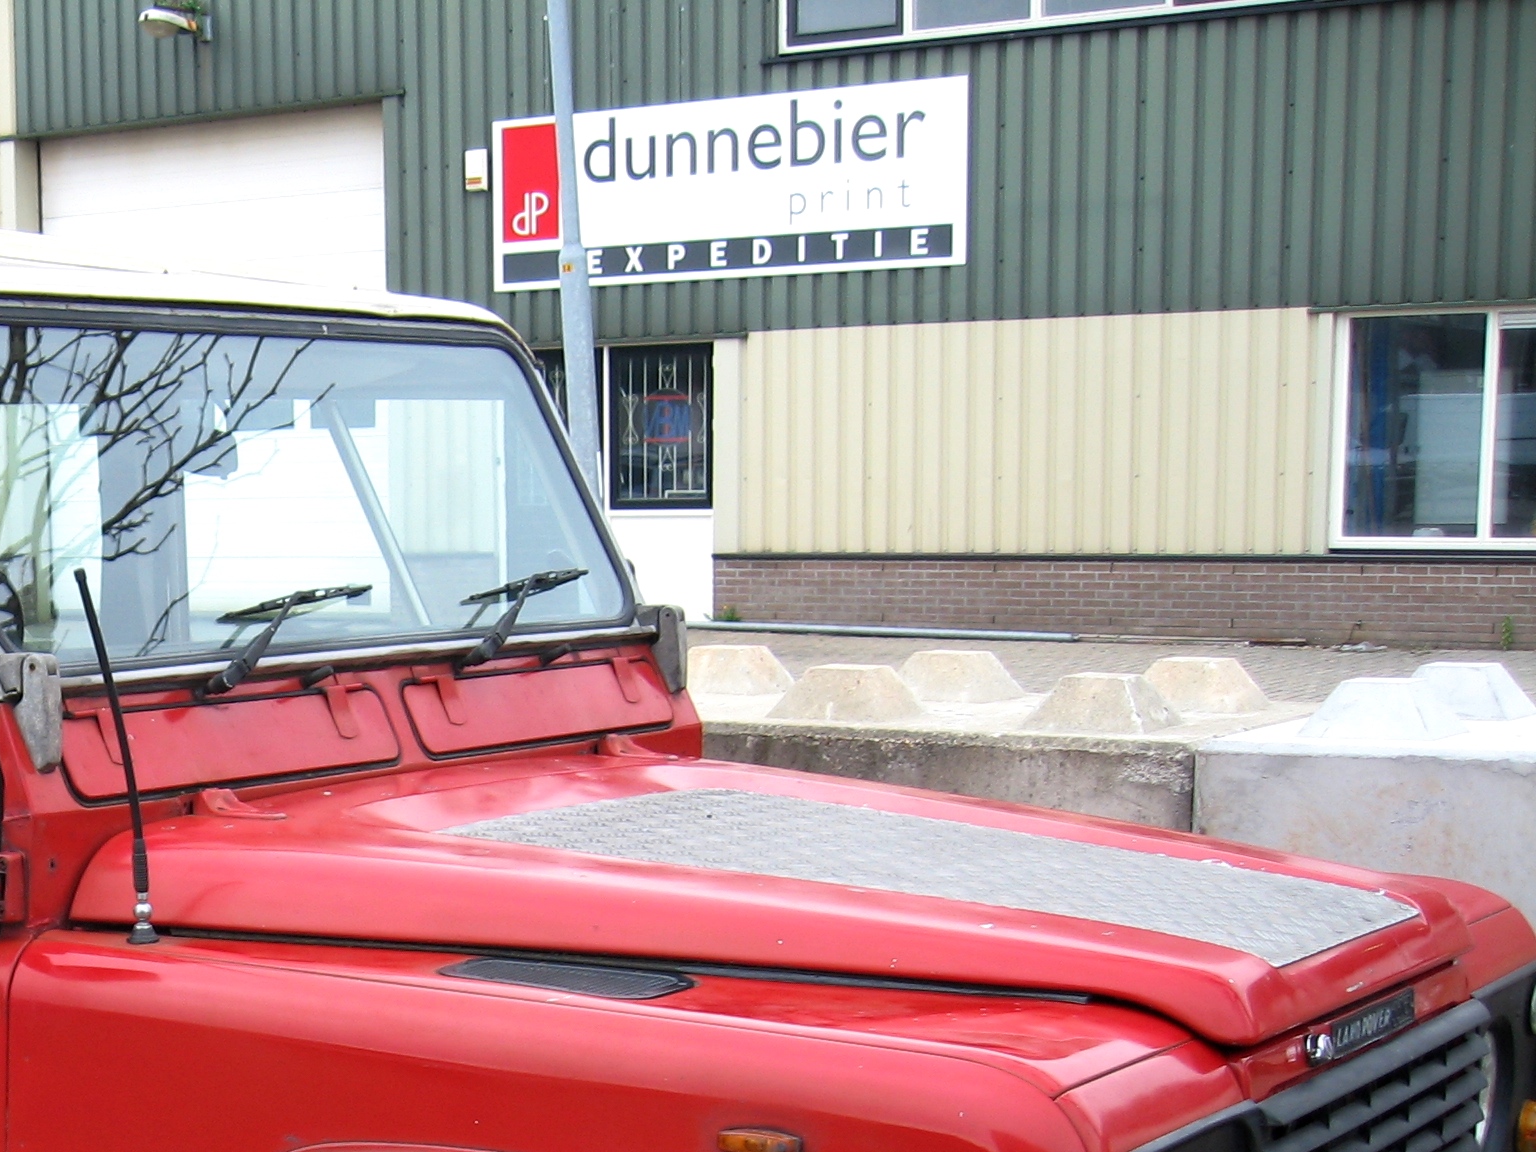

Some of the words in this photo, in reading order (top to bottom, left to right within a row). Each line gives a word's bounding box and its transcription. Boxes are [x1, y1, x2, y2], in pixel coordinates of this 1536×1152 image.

[583, 99, 926, 183] dunnebier
[789, 179, 912, 224] print
[586, 227, 930, 275] EXPEDITIE
